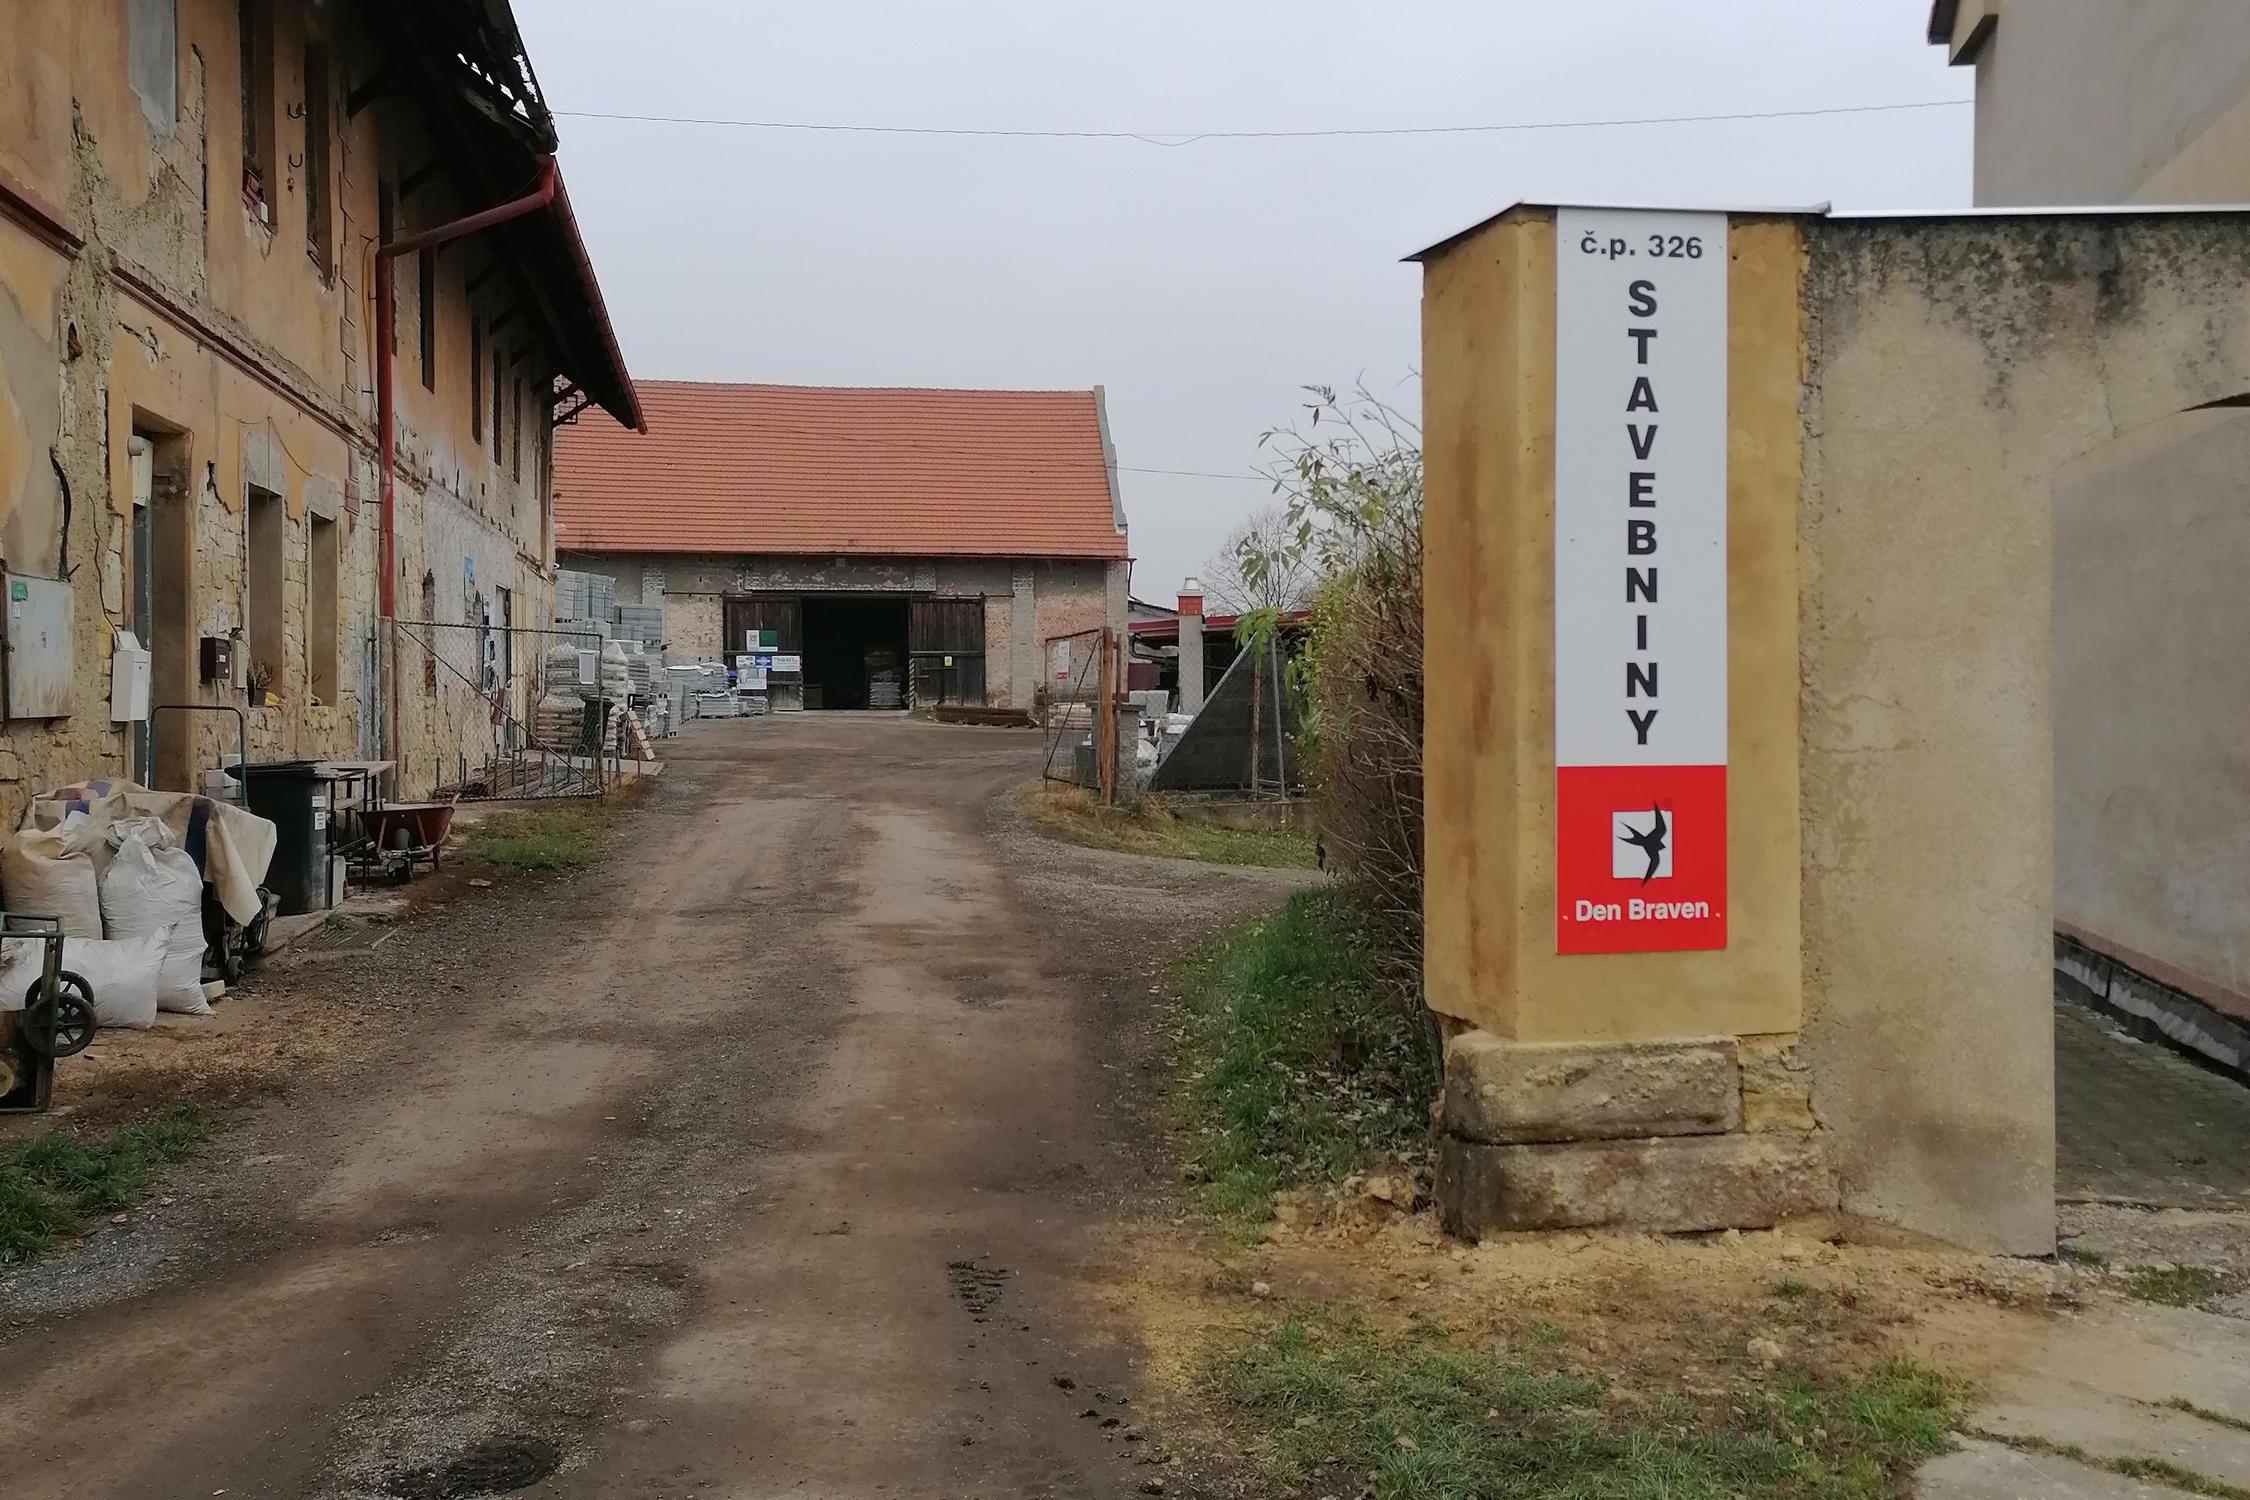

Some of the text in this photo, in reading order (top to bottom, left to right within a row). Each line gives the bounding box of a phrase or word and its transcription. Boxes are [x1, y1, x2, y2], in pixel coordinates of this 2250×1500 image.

[1580, 230, 1703, 260] č.p. 326
[1626, 279, 1659, 745] STAVEBNINY
[1575, 898, 1709, 922] Den Braven
